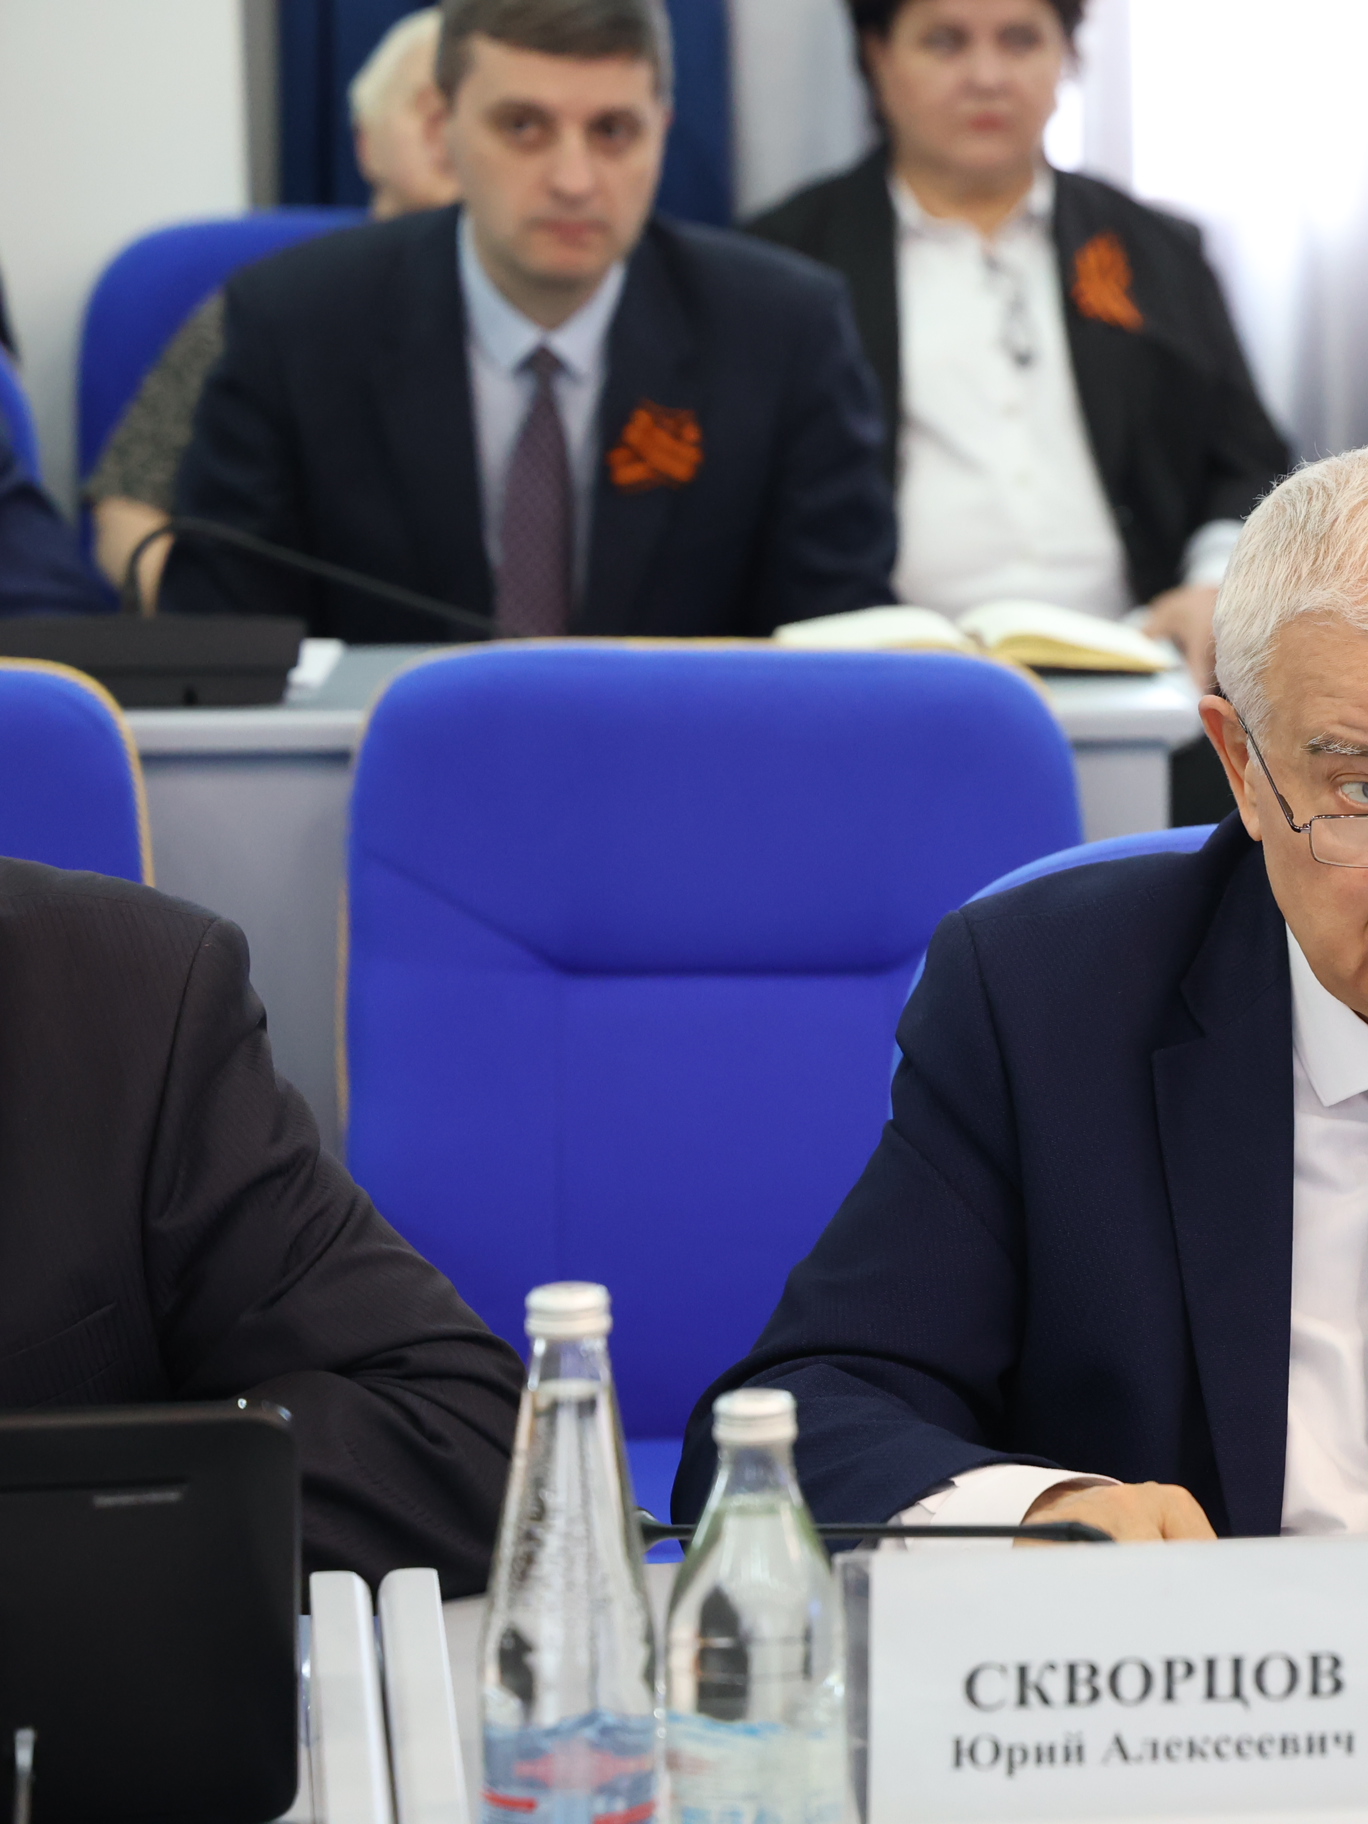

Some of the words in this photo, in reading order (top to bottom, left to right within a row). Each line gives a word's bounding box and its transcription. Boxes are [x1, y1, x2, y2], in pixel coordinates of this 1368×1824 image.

[963, 1651, 1346, 1712] СКВОРЦОВ
[951, 1731, 1087, 1777] Юрий
[1101, 1729, 1357, 1766] Алексеевич
